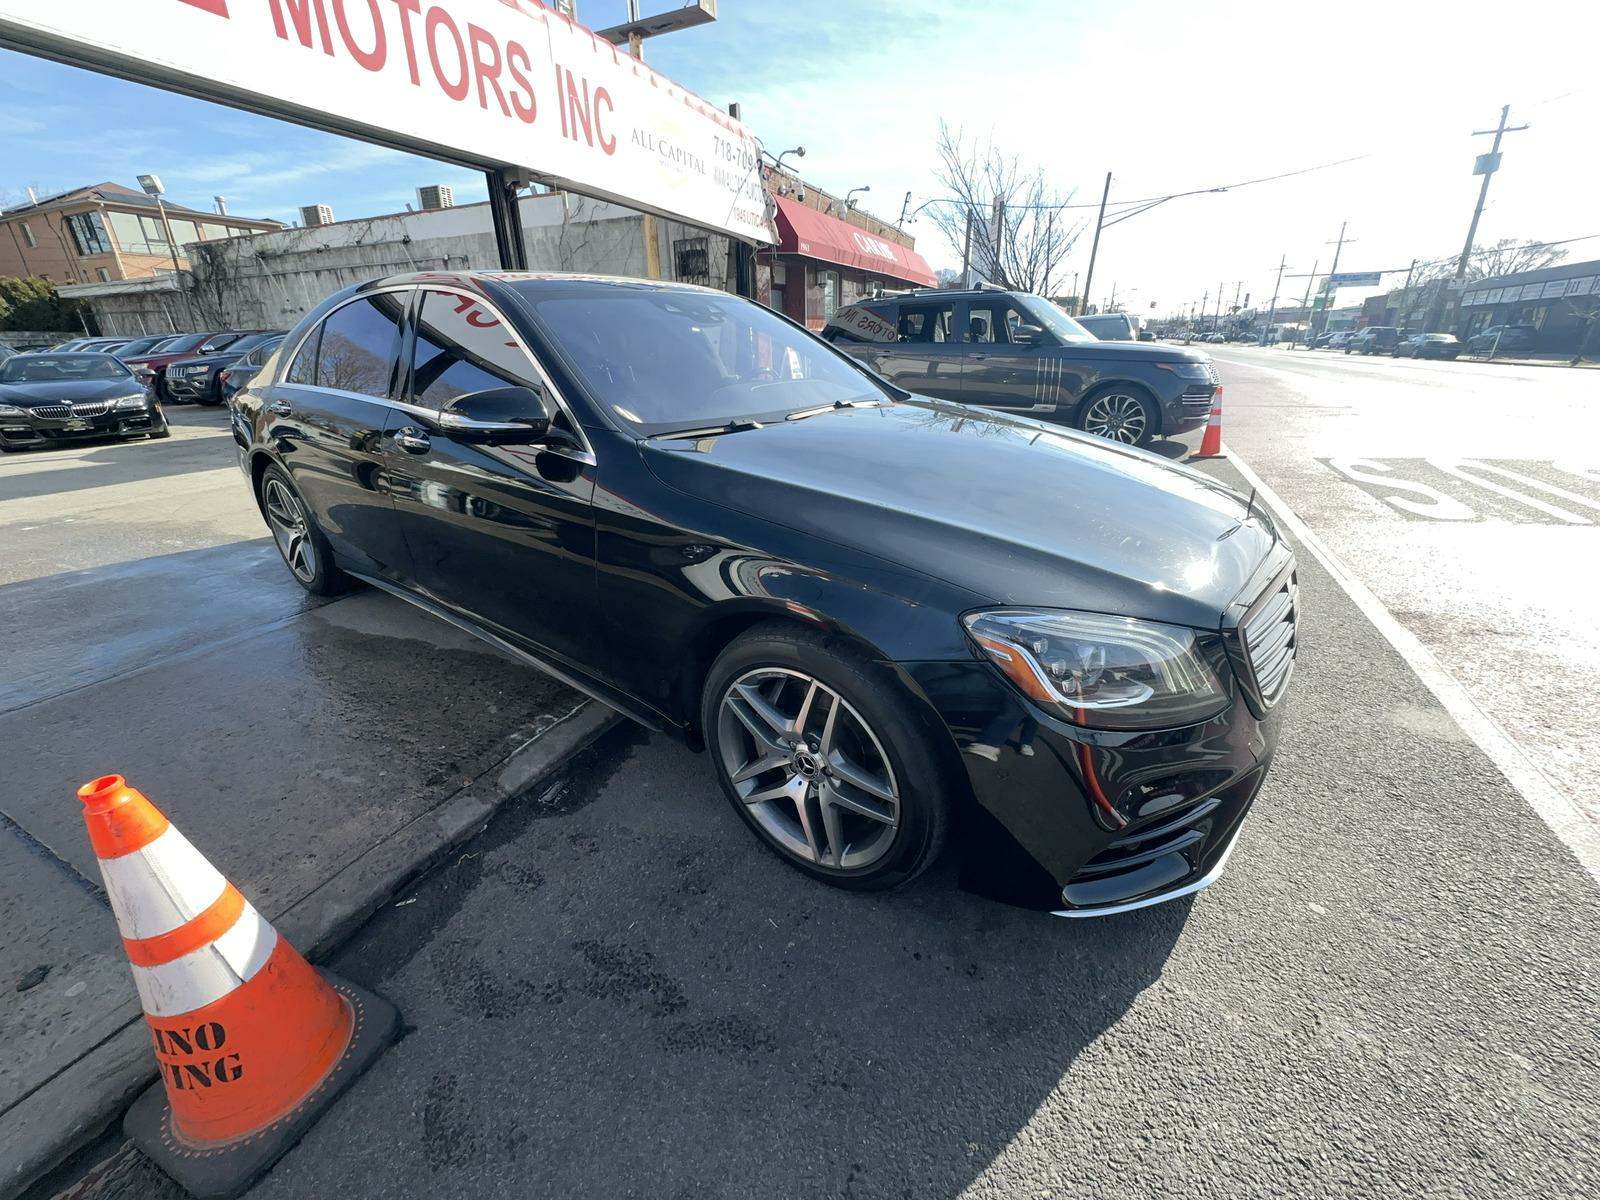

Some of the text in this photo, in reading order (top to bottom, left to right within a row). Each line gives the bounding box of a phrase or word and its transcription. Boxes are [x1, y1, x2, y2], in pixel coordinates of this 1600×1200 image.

[555, 63, 617, 156] INC
[631, 128, 655, 152] ALL
[658, 139, 707, 175] CAPITAL
